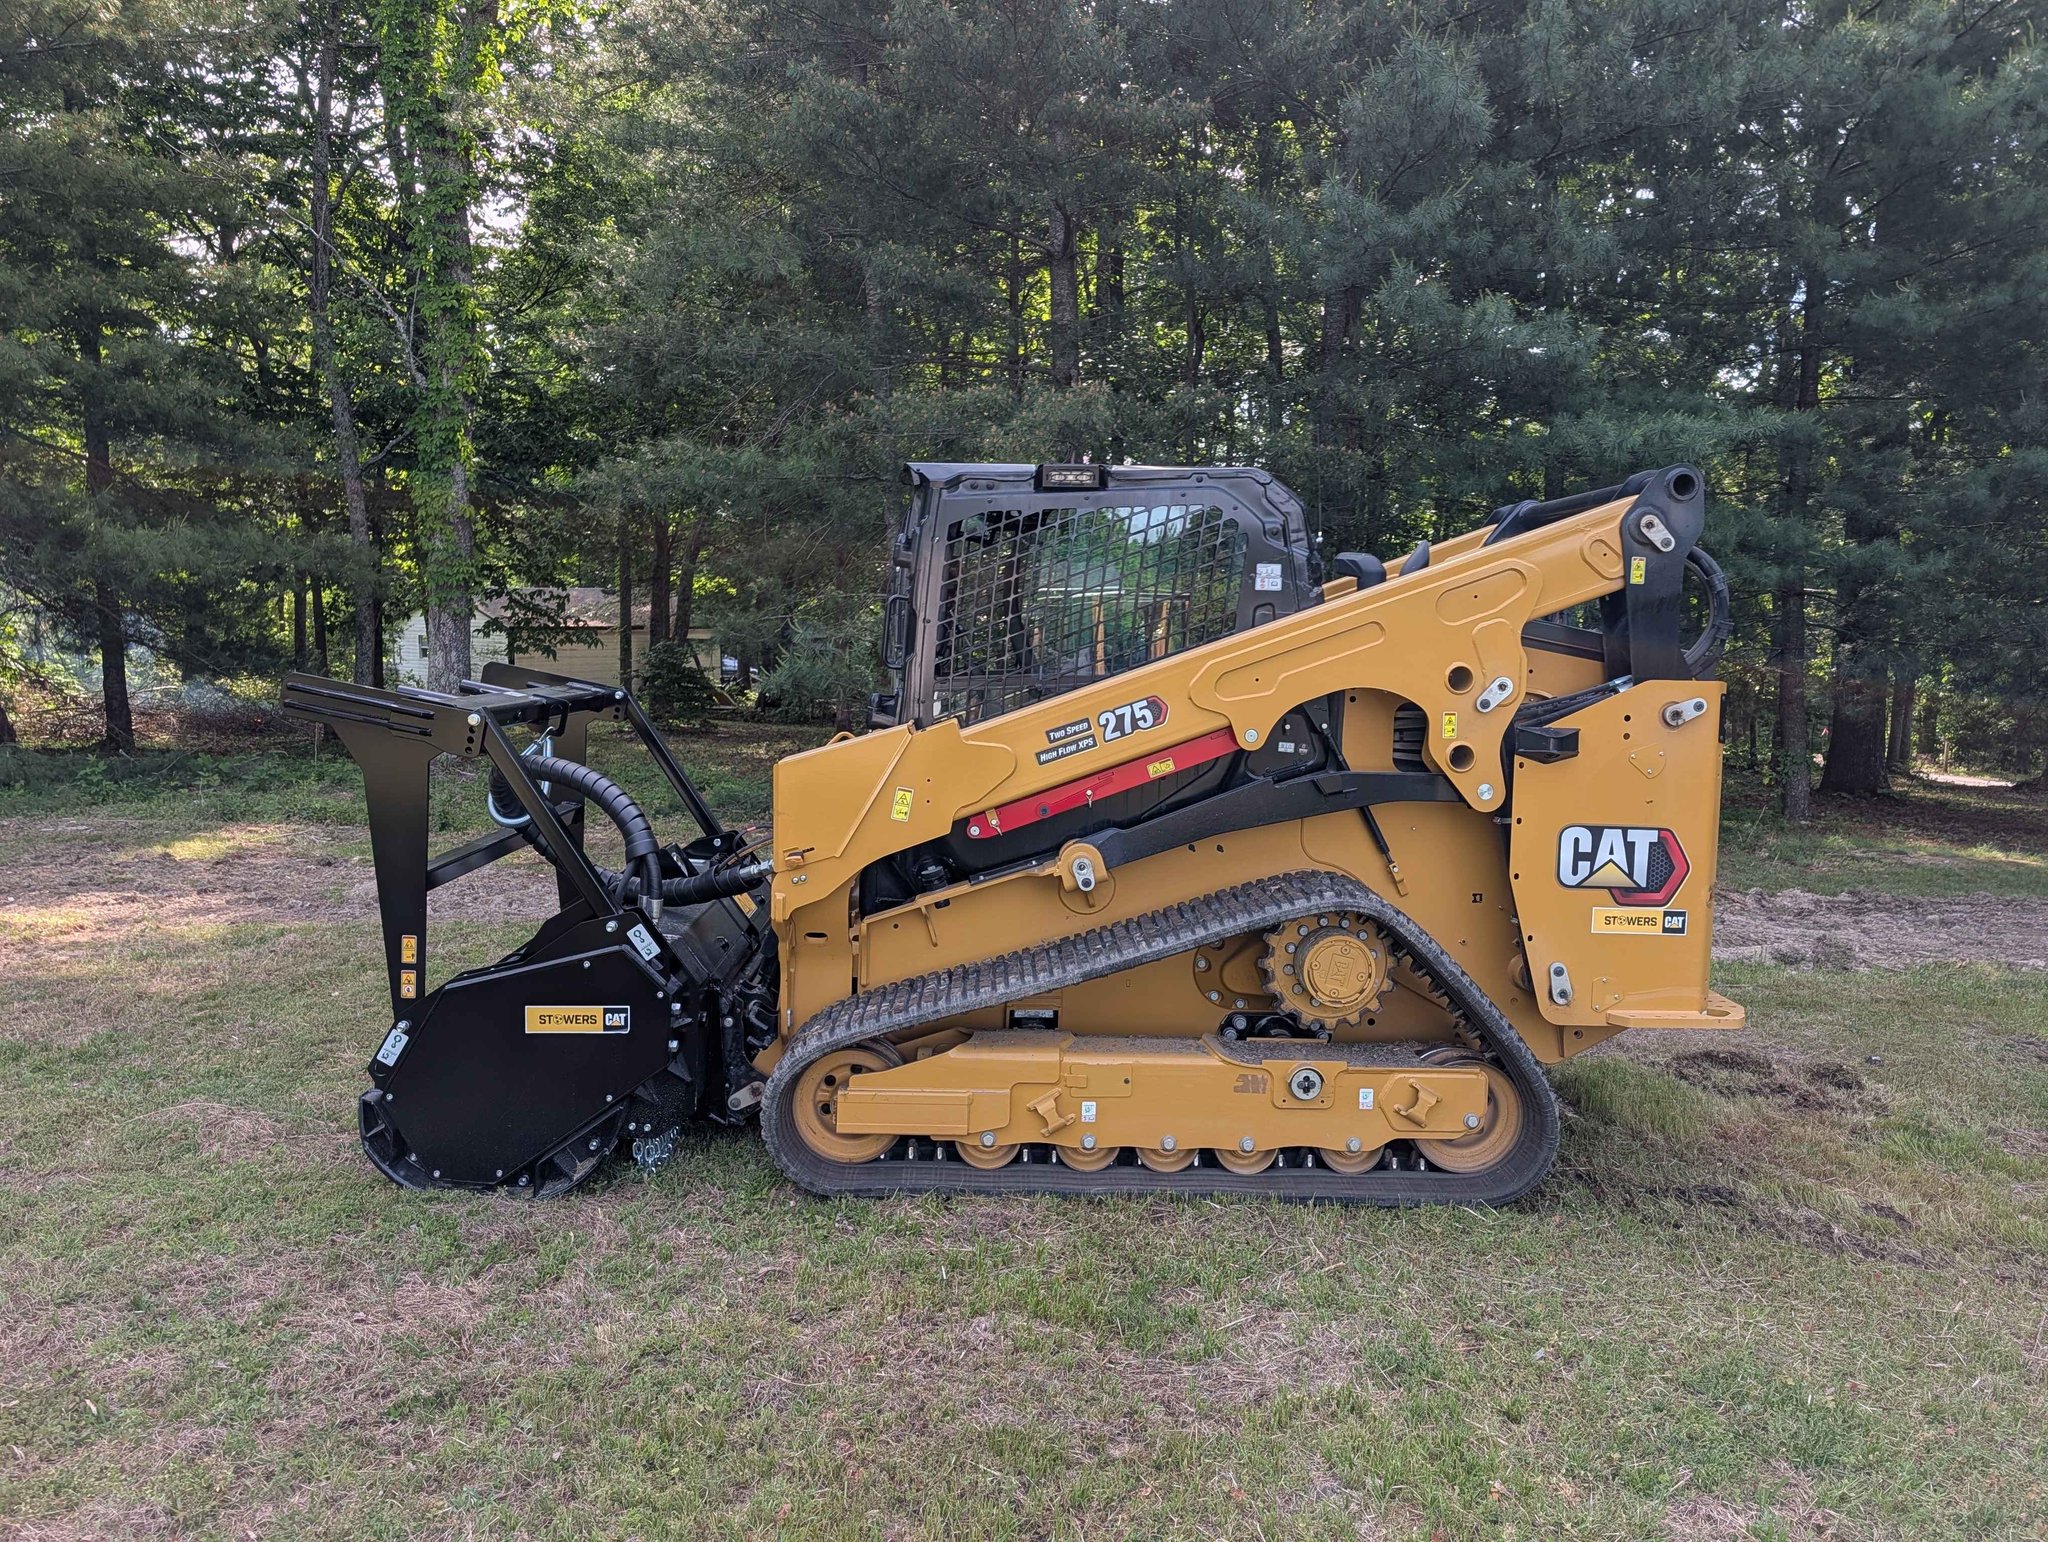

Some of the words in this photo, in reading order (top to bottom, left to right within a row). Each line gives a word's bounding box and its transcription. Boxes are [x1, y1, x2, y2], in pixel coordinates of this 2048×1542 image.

[1098, 700, 1154, 741] 275
[1078, 738, 1094, 749] XPS
[1559, 826, 1659, 888] CAT
[1664, 916, 1685, 929] CAT
[605, 1013, 627, 1026] CAT
